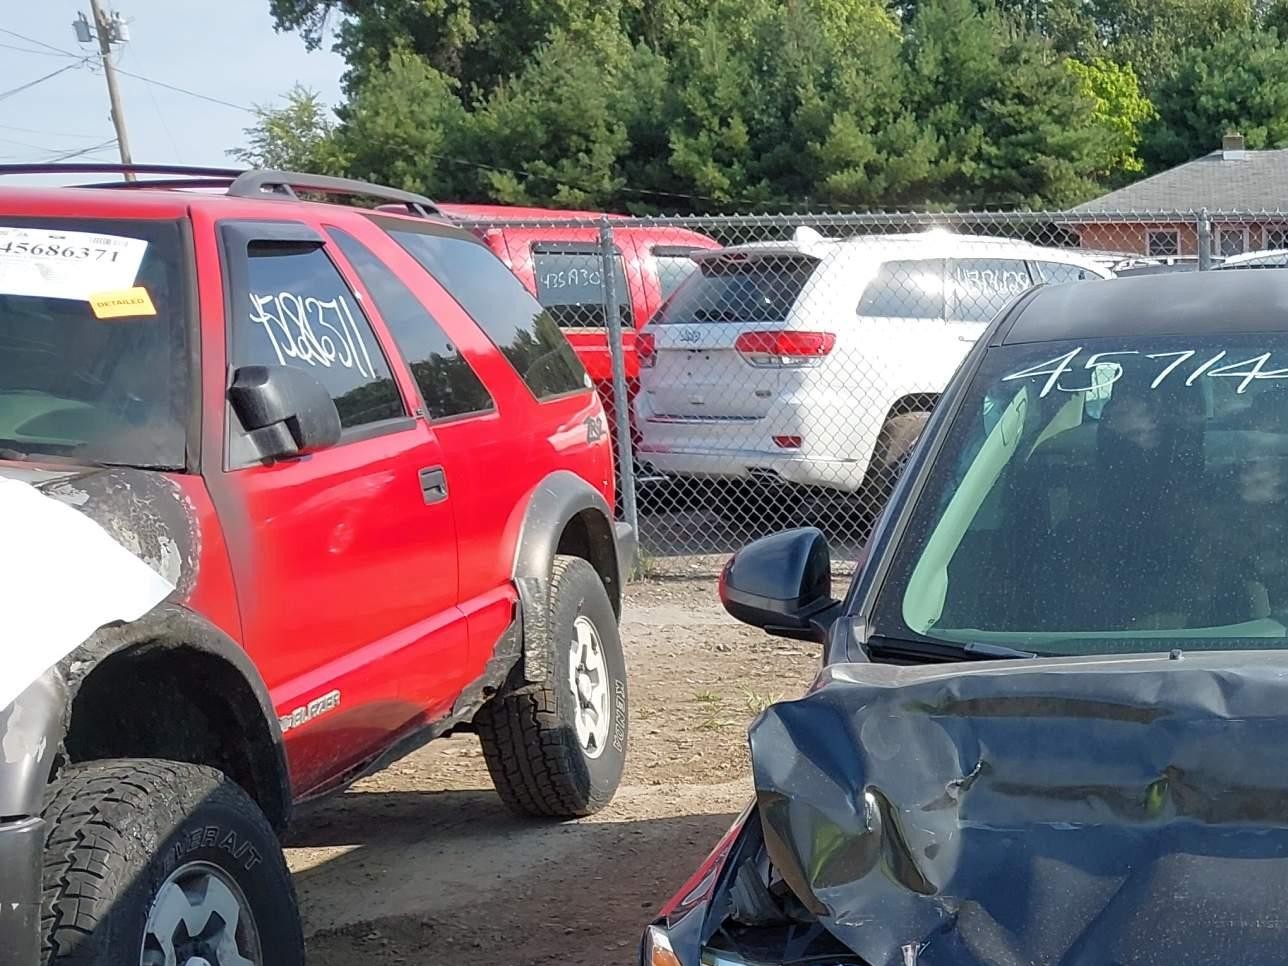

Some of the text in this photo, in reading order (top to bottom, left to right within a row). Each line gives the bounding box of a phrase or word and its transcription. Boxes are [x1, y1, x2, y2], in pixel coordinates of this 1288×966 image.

[0, 241, 119, 262] 45686371
[97, 298, 145, 308] DETAILED
[291, 689, 341, 728] BLAZER
[613, 679, 626, 753] KENDA
